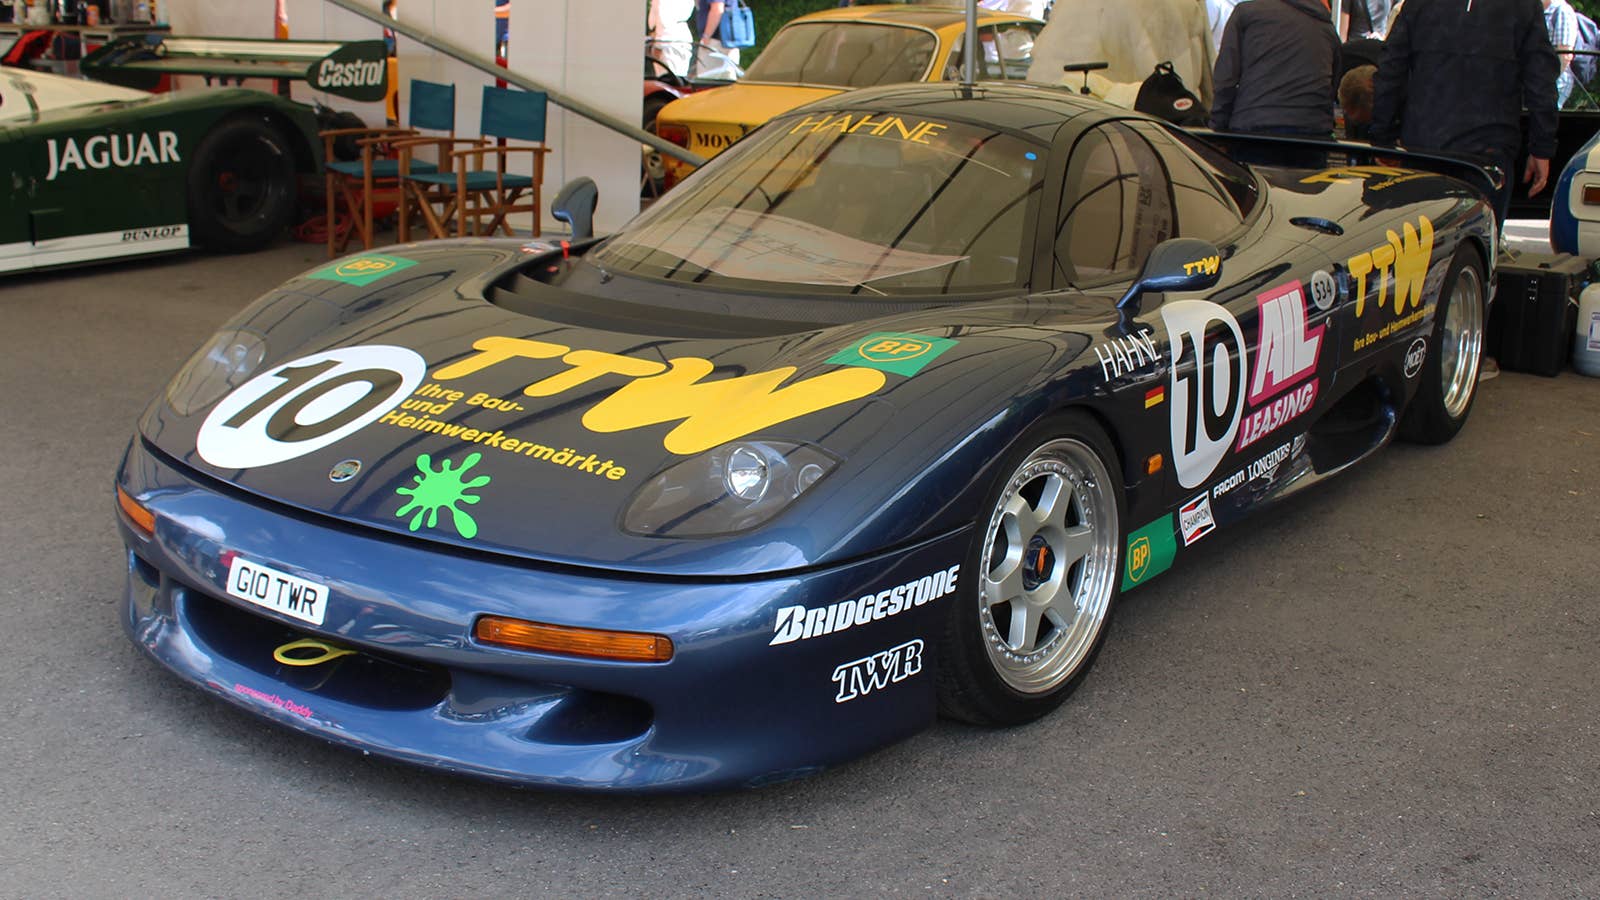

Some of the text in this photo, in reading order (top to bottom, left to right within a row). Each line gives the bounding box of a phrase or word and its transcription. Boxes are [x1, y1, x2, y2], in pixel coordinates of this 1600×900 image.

[317, 58, 386, 88] Castrol
[790, 113, 947, 144] HAHNE
[46, 131, 181, 181] JAGUAR
[121, 226, 182, 242] DUNLOP
[1183, 255, 1220, 276] TTW
[1347, 214, 1434, 318] TTW
[1314, 279, 1332, 301] 534
[868, 341, 922, 355] BP
[1094, 328, 1162, 382] HAHNE
[223, 359, 402, 442] 10
[415, 383, 524, 414] Ihre Bau-
[432, 336, 886, 454] TTW
[1174, 318, 1240, 457] 10
[401, 399, 447, 416] und
[1240, 383, 1314, 449] LEASING
[378, 409, 627, 481] Heimwerkermärkte
[1247, 442, 1291, 481] LONGINES
[1213, 469, 1245, 499] FACOM
[1132, 545, 1148, 571] BP
[237, 566, 317, 617] G10 TWR
[769, 564, 960, 646] BRIDGESTONE
[832, 639, 924, 703] TWR
[285, 700, 313, 720] Daddy
